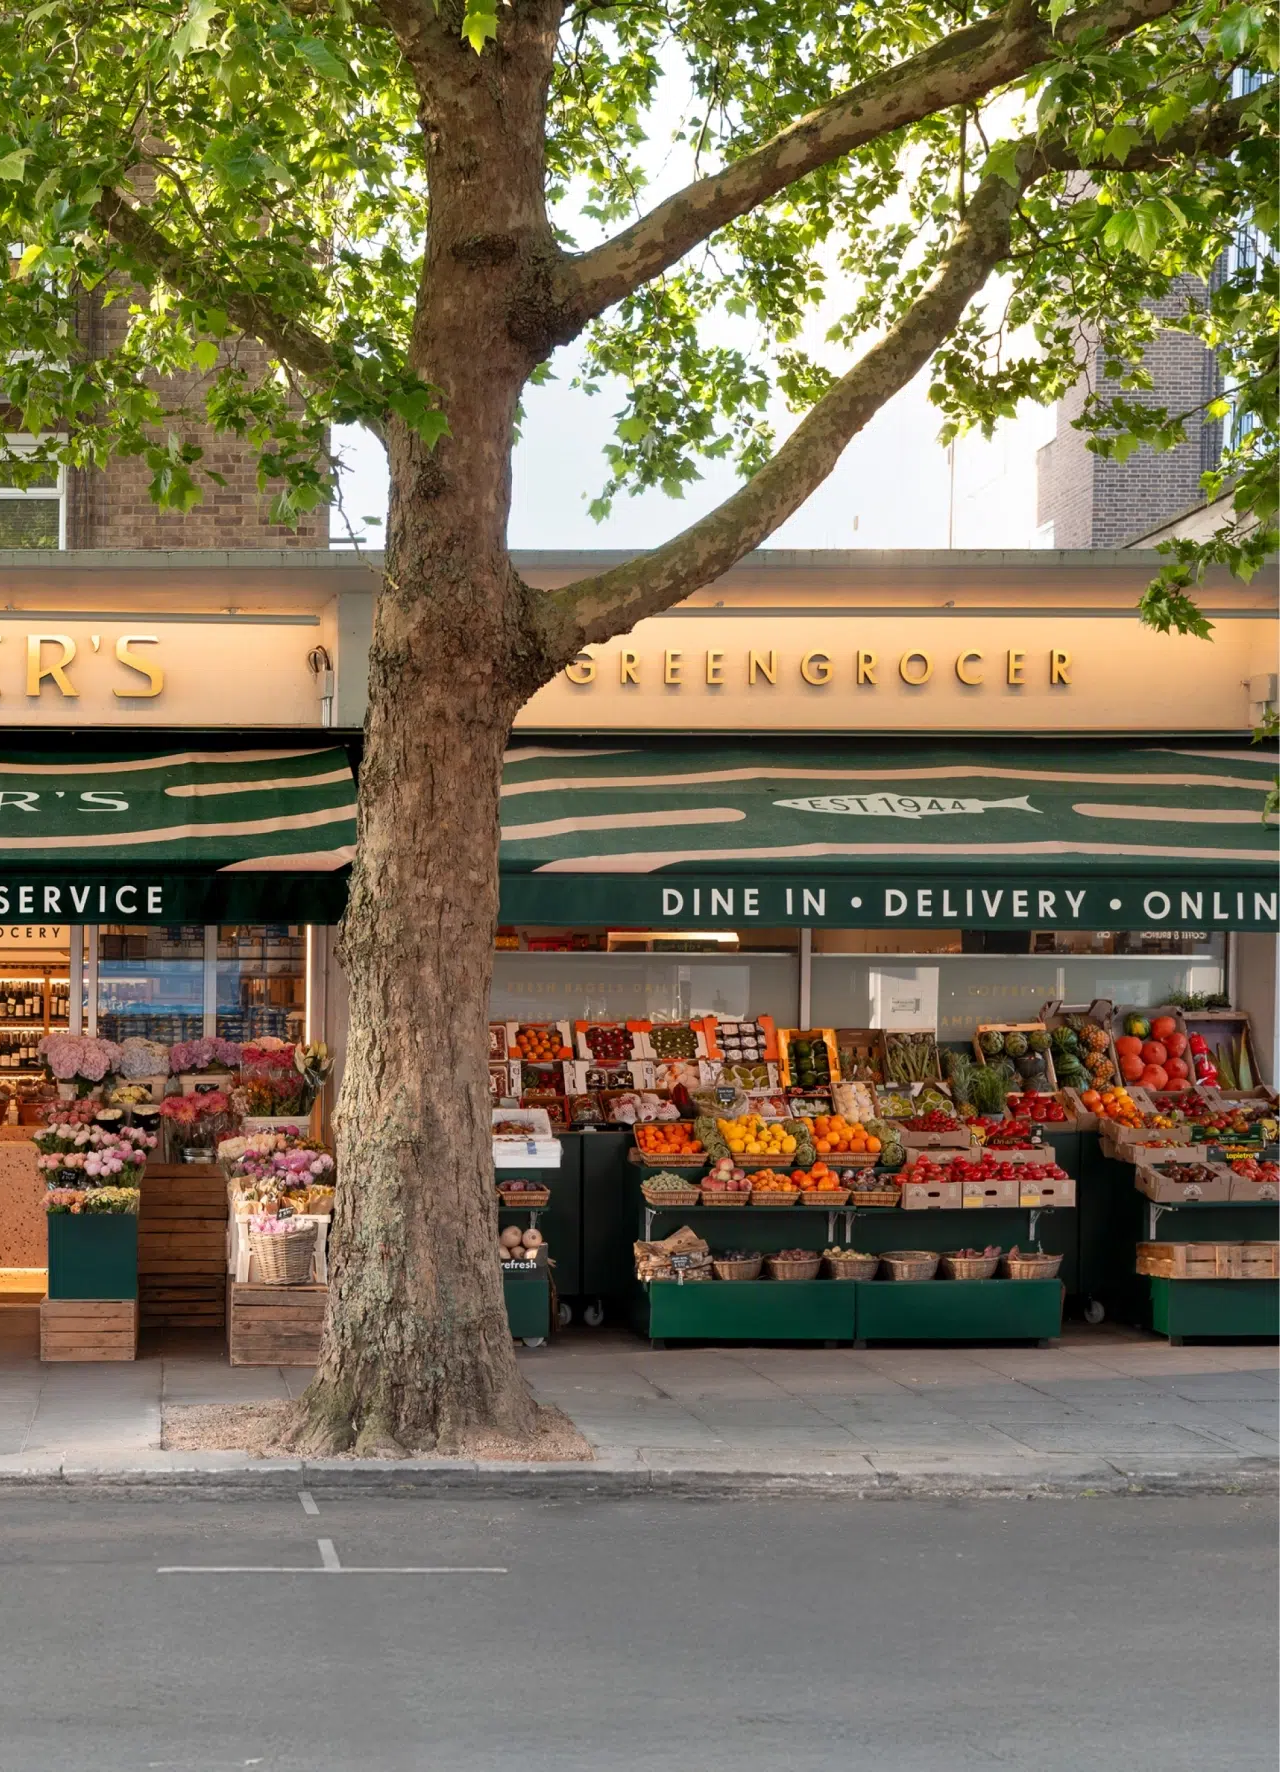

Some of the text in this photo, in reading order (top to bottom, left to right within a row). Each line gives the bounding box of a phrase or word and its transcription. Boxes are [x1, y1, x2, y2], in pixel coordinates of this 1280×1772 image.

[564, 648, 1074, 685] GREENGROCER
[663, 888, 1277, 920] DINE IN DELIVERY ONLIN
